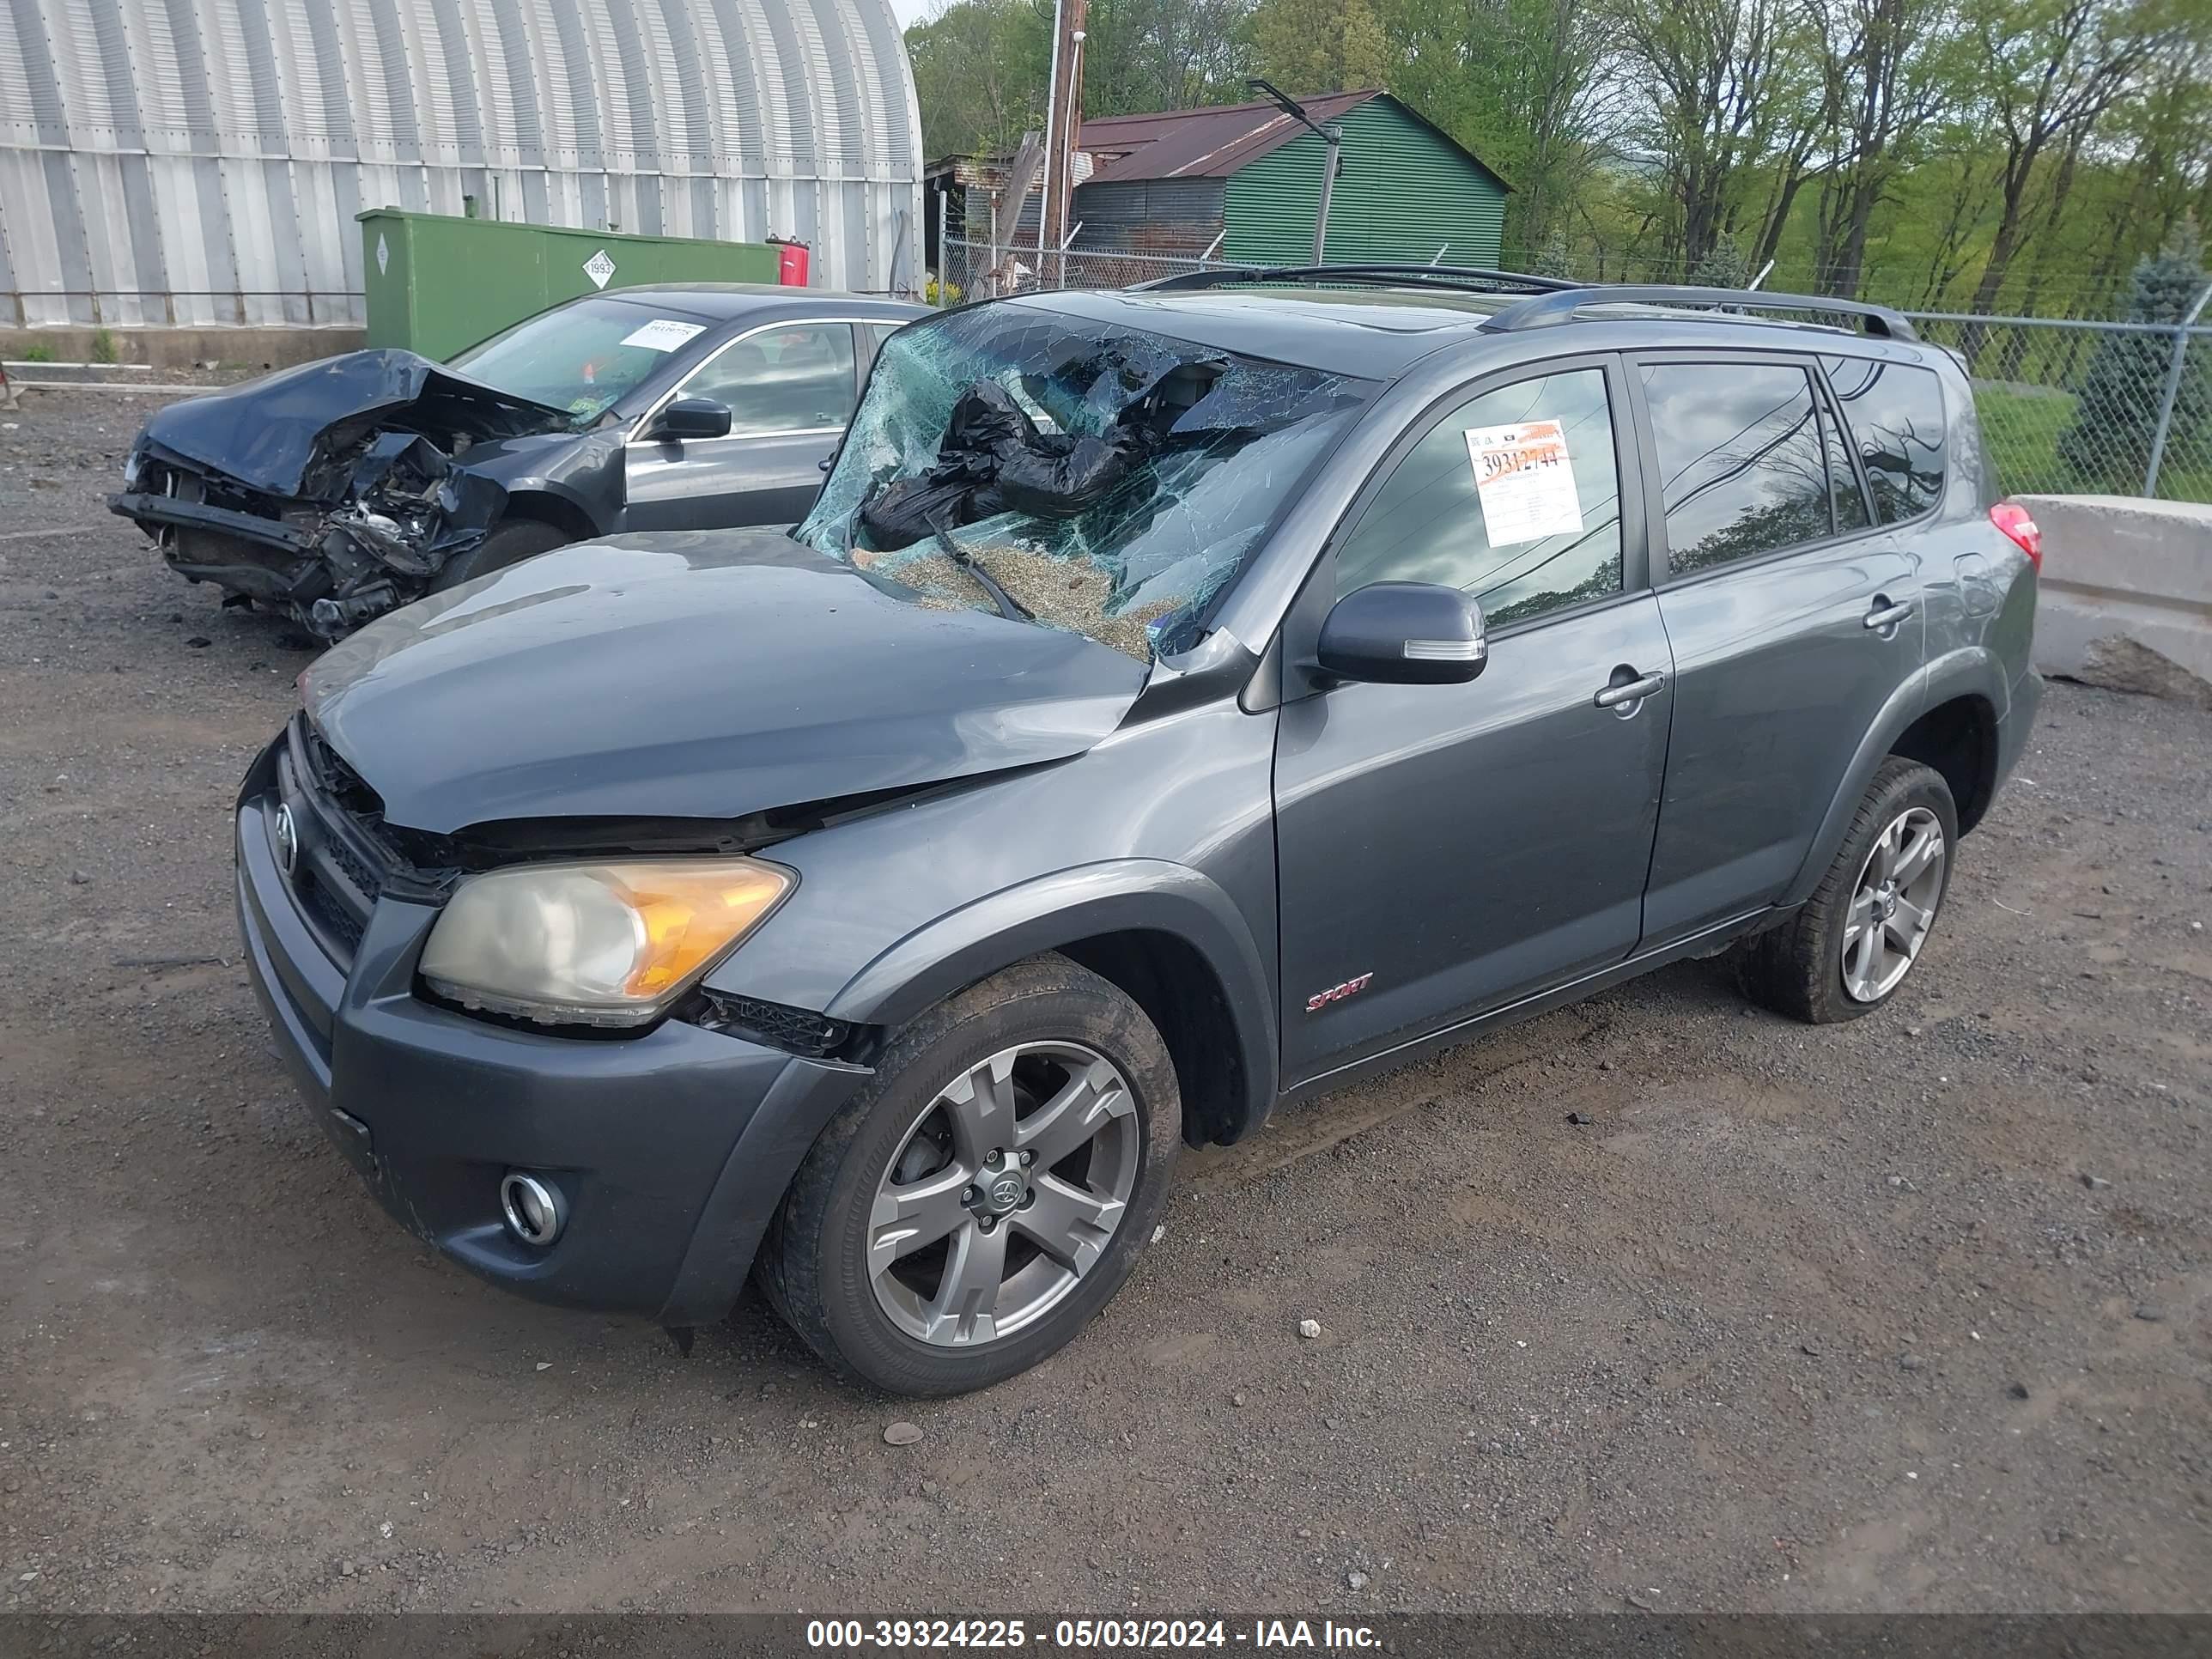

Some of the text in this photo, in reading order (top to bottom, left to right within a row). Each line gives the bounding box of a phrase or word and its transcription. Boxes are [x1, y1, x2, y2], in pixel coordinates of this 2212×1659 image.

[591, 263, 611, 274] 1993
[1482, 448, 1559, 477] 39312744
[1305, 972, 1374, 1012] SPORT
